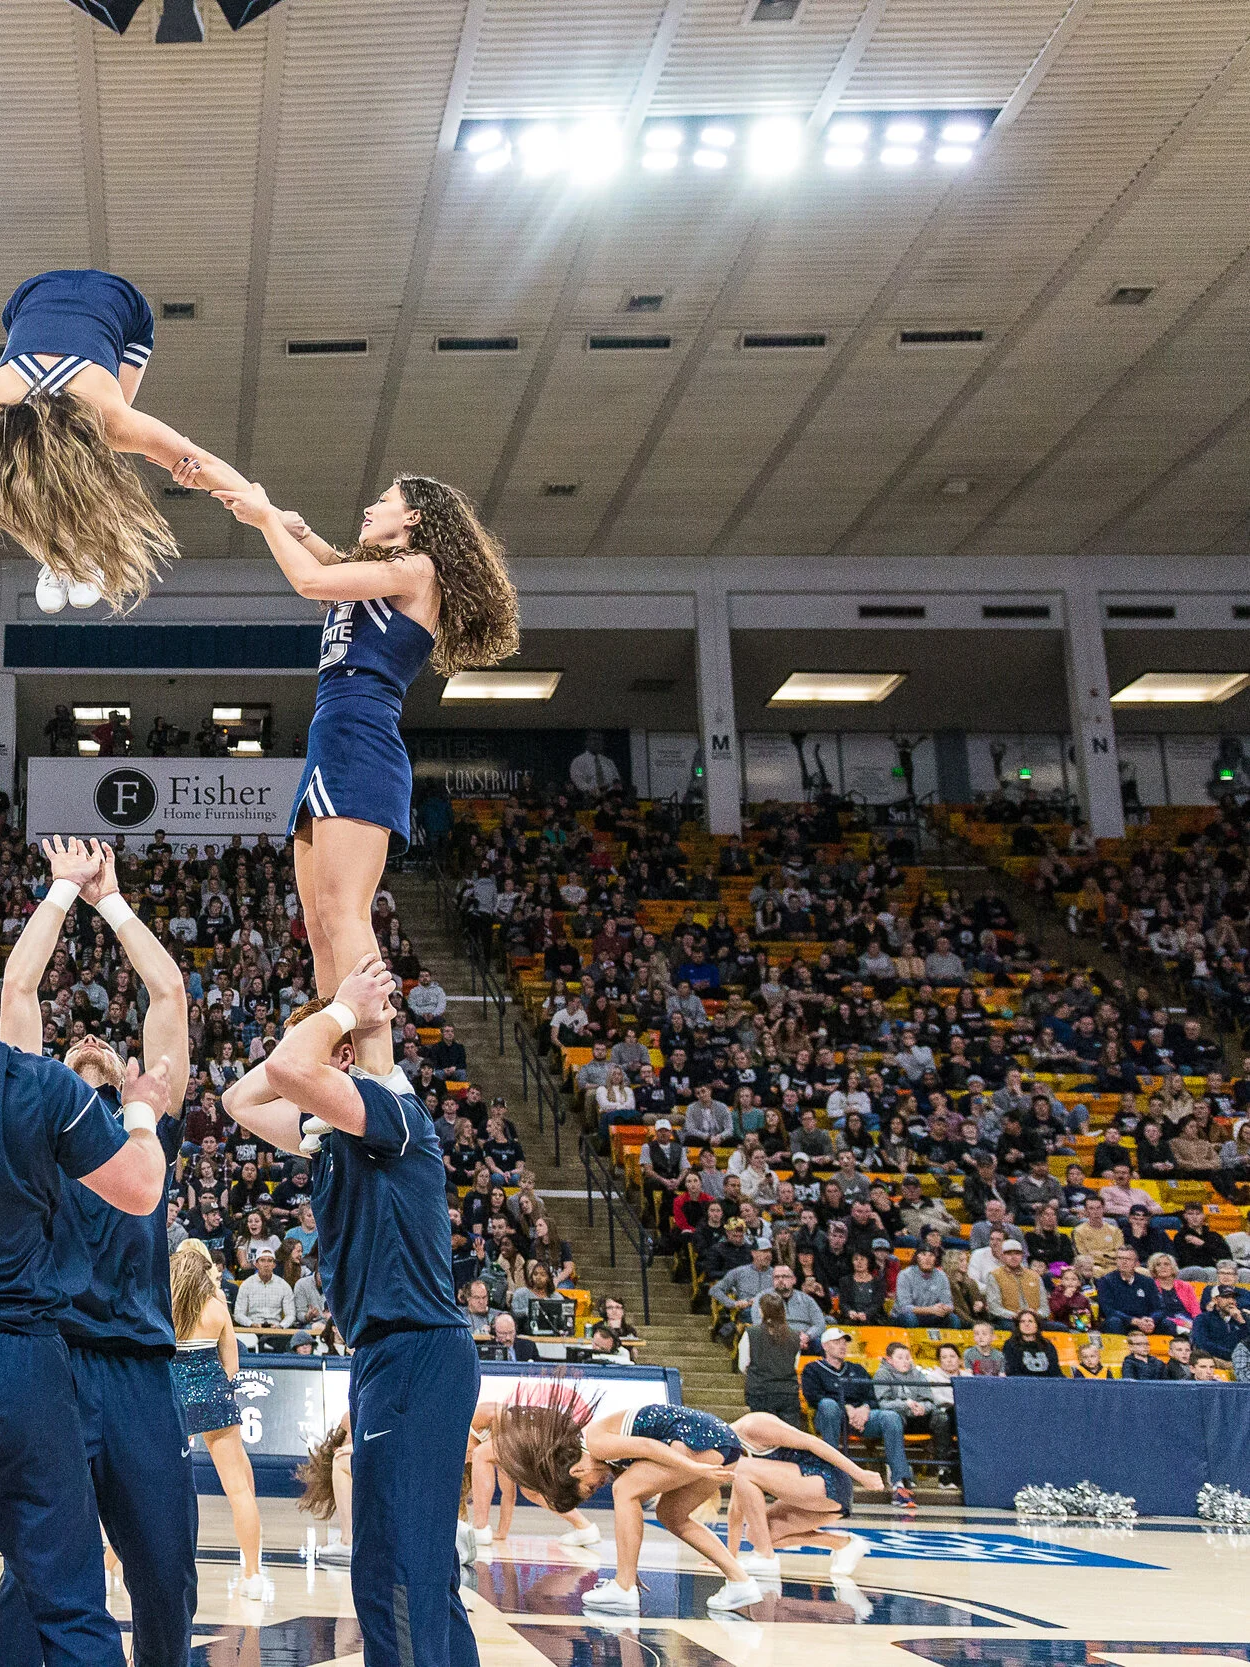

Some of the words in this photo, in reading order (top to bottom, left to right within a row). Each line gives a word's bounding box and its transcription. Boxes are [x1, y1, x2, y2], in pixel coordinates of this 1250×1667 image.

[712, 734, 730, 750] M
[1092, 737, 1109, 753] N
[168, 774, 271, 805] Fisher
[112, 781, 140, 815] F
[163, 808, 201, 820] Home
[205, 807, 278, 823] Furnishings
[235, 1371, 275, 1386] EVADA
[240, 1407, 263, 1444] 6
